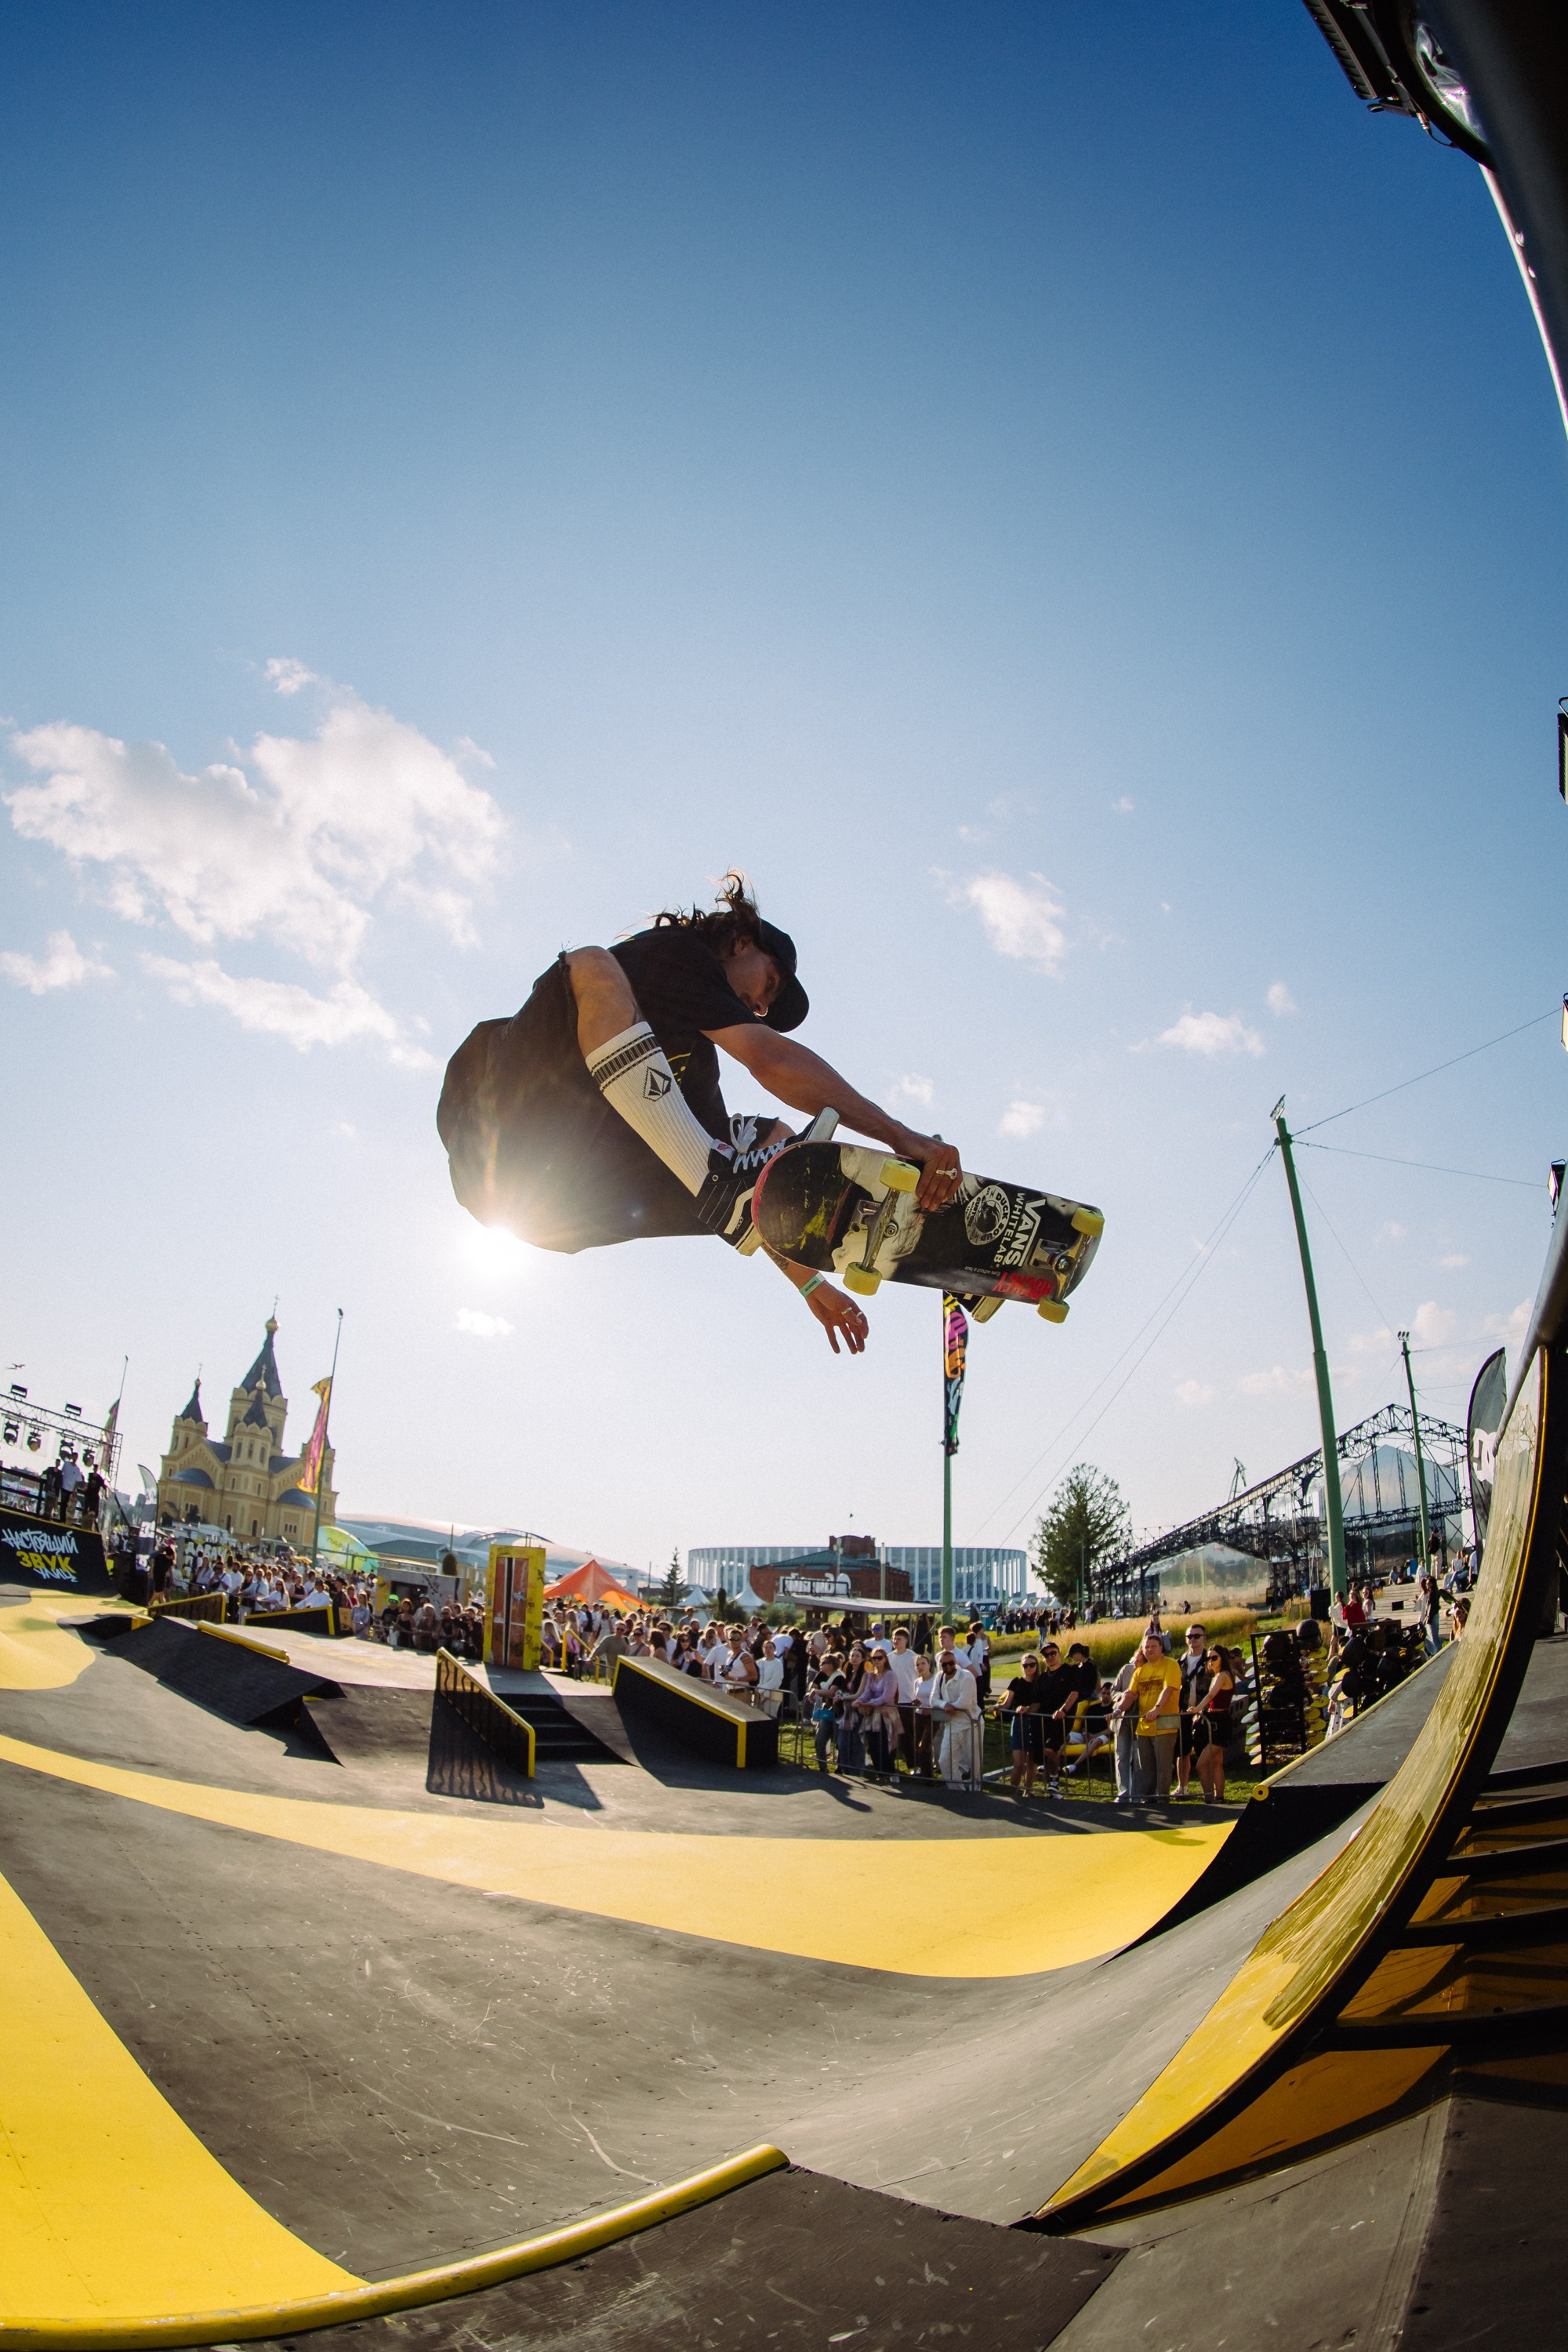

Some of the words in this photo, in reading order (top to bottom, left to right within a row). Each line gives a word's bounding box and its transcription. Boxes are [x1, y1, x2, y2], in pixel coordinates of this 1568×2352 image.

[993, 1192, 1026, 1263] WHITELAB
[995, 1192, 1010, 1219] DUCK
[1004, 1199, 1047, 1267] VANS
[16, 1552, 77, 1573] ЗВУК
